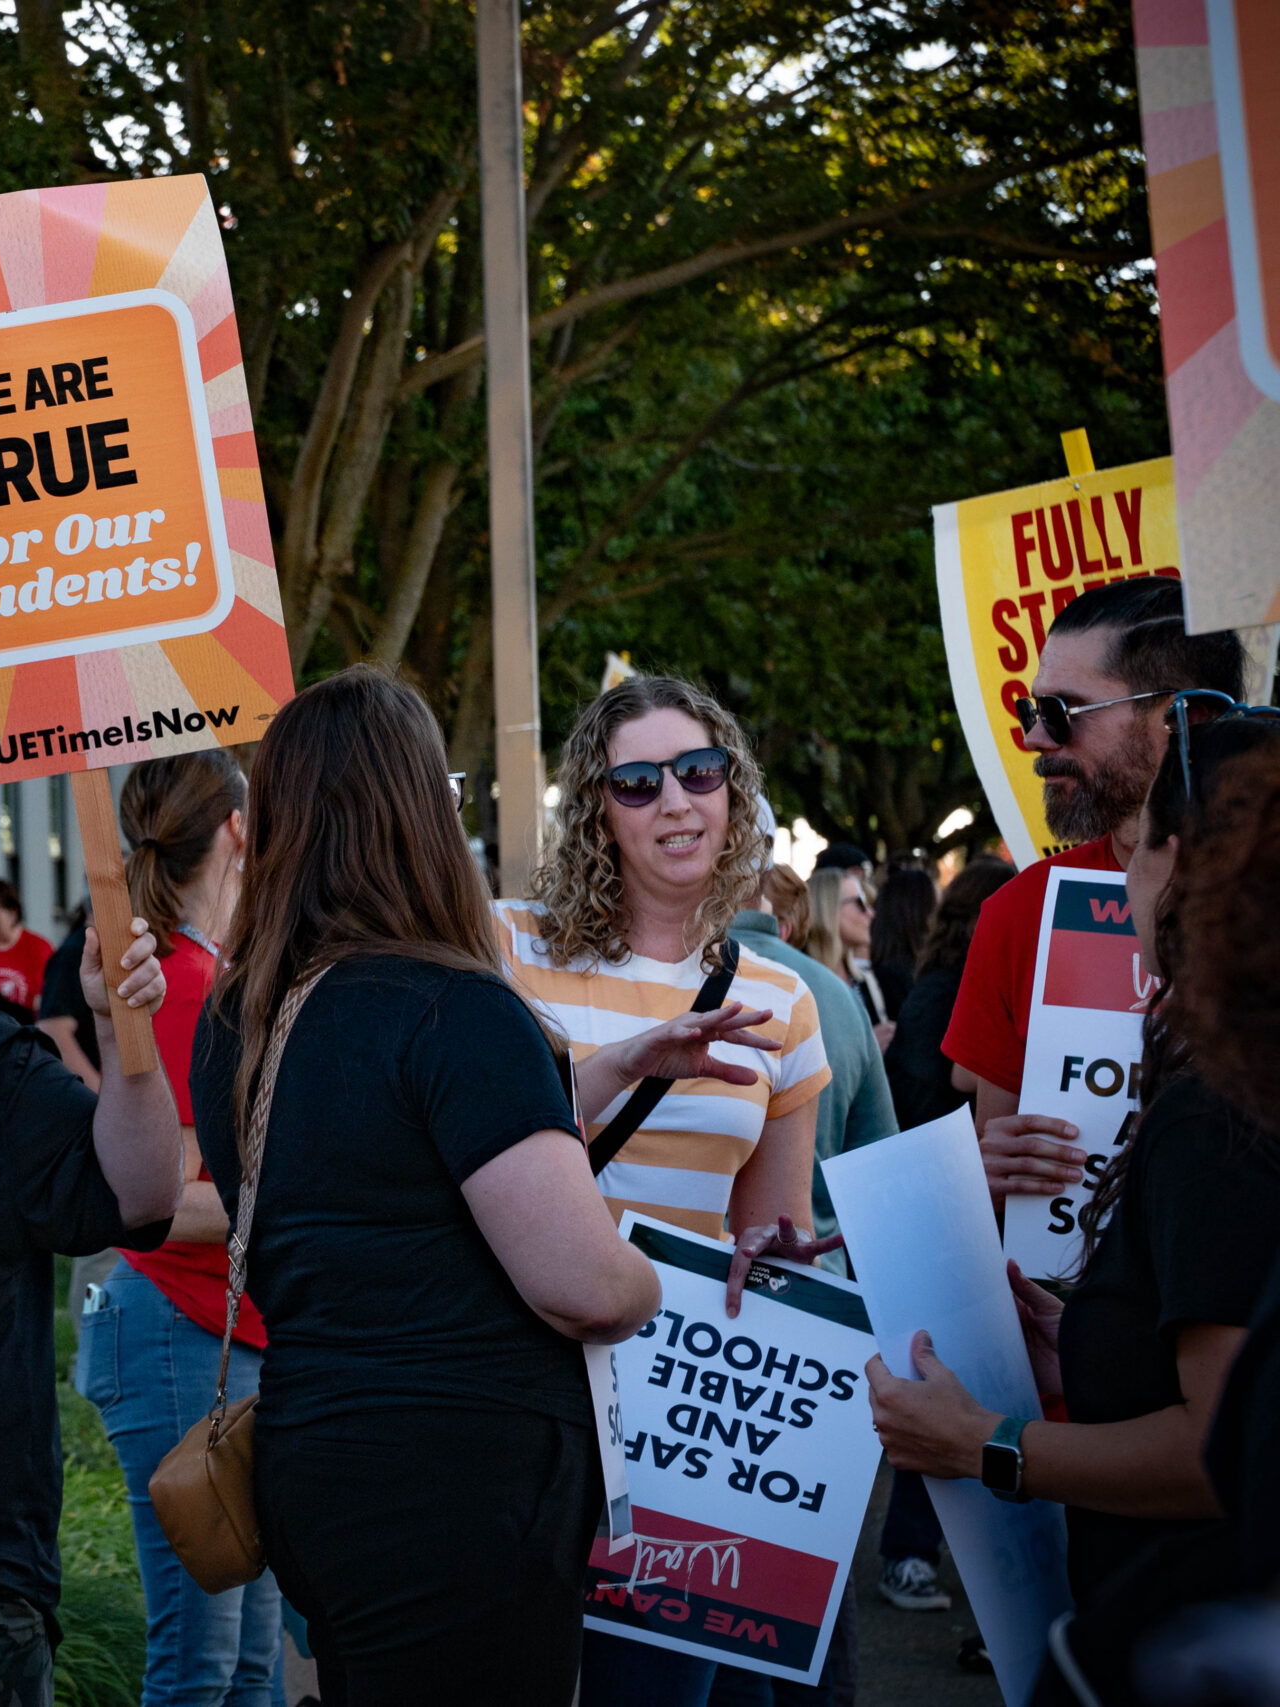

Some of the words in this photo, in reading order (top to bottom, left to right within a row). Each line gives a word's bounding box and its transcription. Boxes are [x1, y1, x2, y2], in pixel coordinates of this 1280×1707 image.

[24, 356, 114, 411] ARE
[54, 507, 166, 557] Our
[1011, 486, 1143, 588] FULLY
[1088, 897, 1132, 925] W
[647, 1353, 818, 1429] STABLE
[624, 1430, 713, 1480] SAF
[666, 1403, 781, 1456] AND
[727, 1457, 827, 1513] FOR
[596, 1532, 748, 1603] Wait
[586, 1579, 692, 1623] CAN'
[703, 1608, 779, 1649] WE
